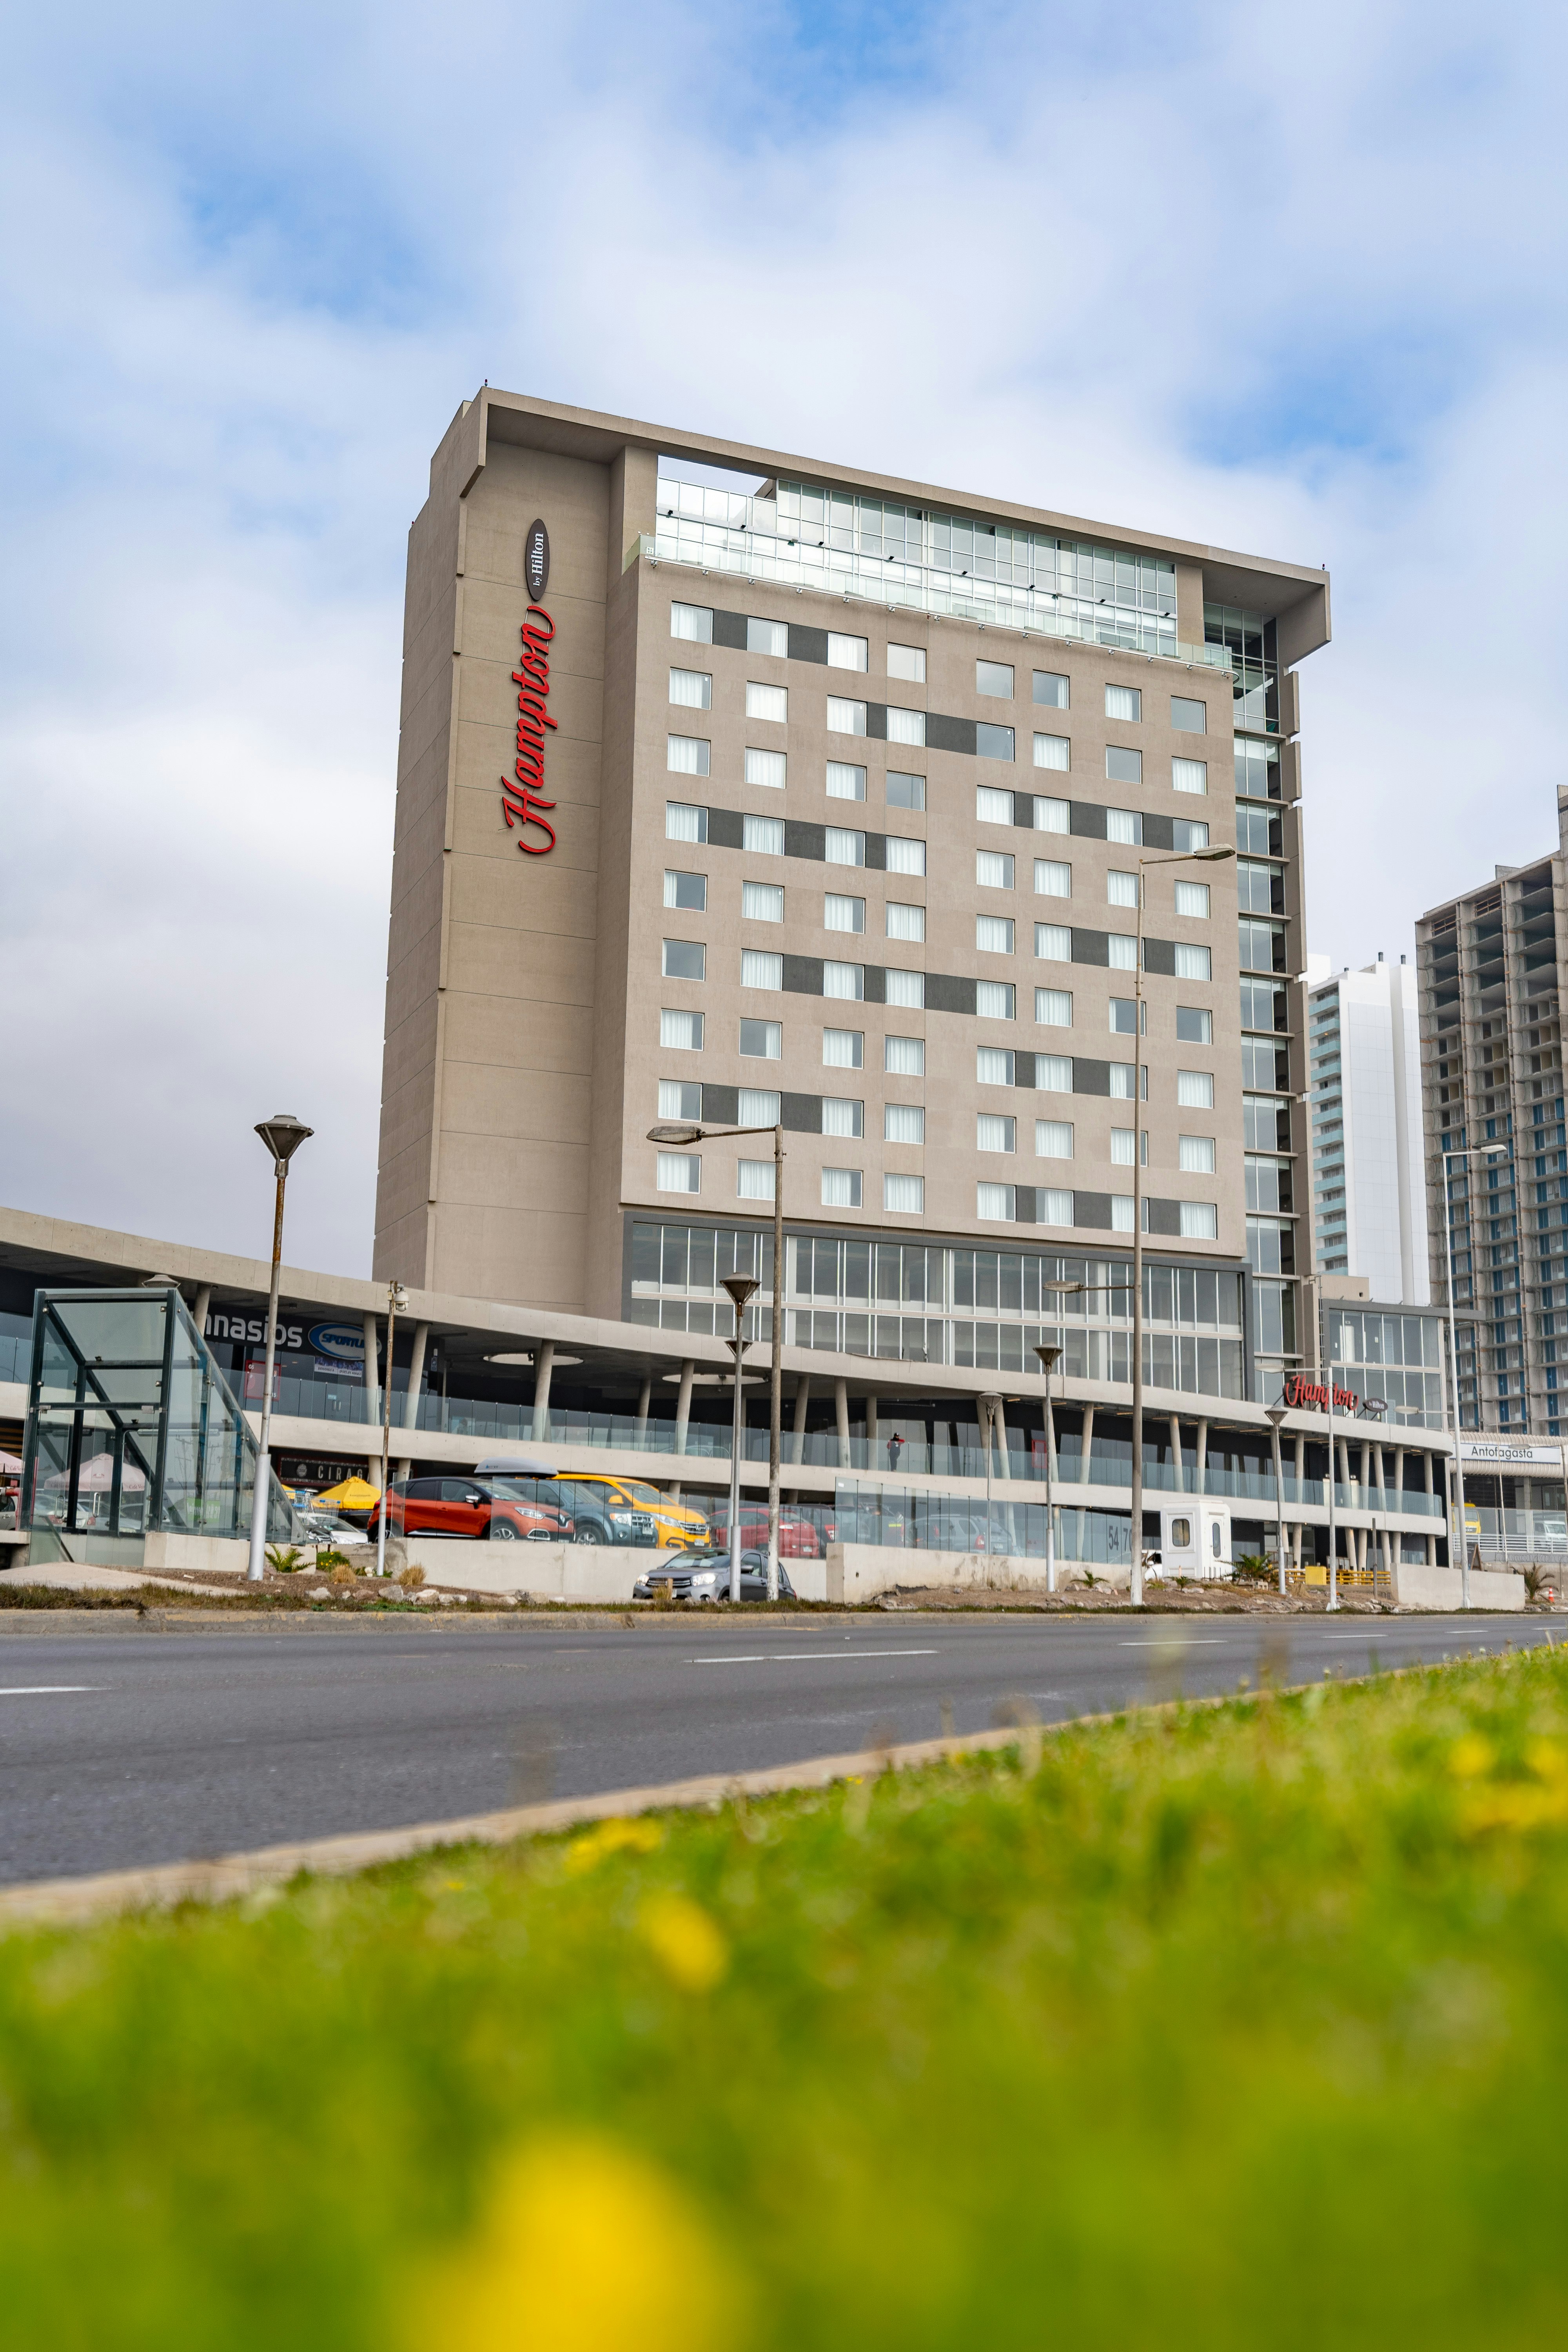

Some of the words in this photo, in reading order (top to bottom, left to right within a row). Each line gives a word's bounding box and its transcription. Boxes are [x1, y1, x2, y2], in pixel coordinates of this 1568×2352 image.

[531, 533, 544, 575] Hilton
[533, 576, 542, 586] by
[501, 605, 557, 854] Hampton
[206, 1314, 302, 1348] nasios
[1287, 1376, 1358, 1410] Hampton
[1372, 1401, 1385, 1410] Hilton
[1471, 1446, 1533, 1459] Antofagasta
[318, 1465, 369, 1482] CIRAG
[1109, 1525, 1119, 1551] 54
